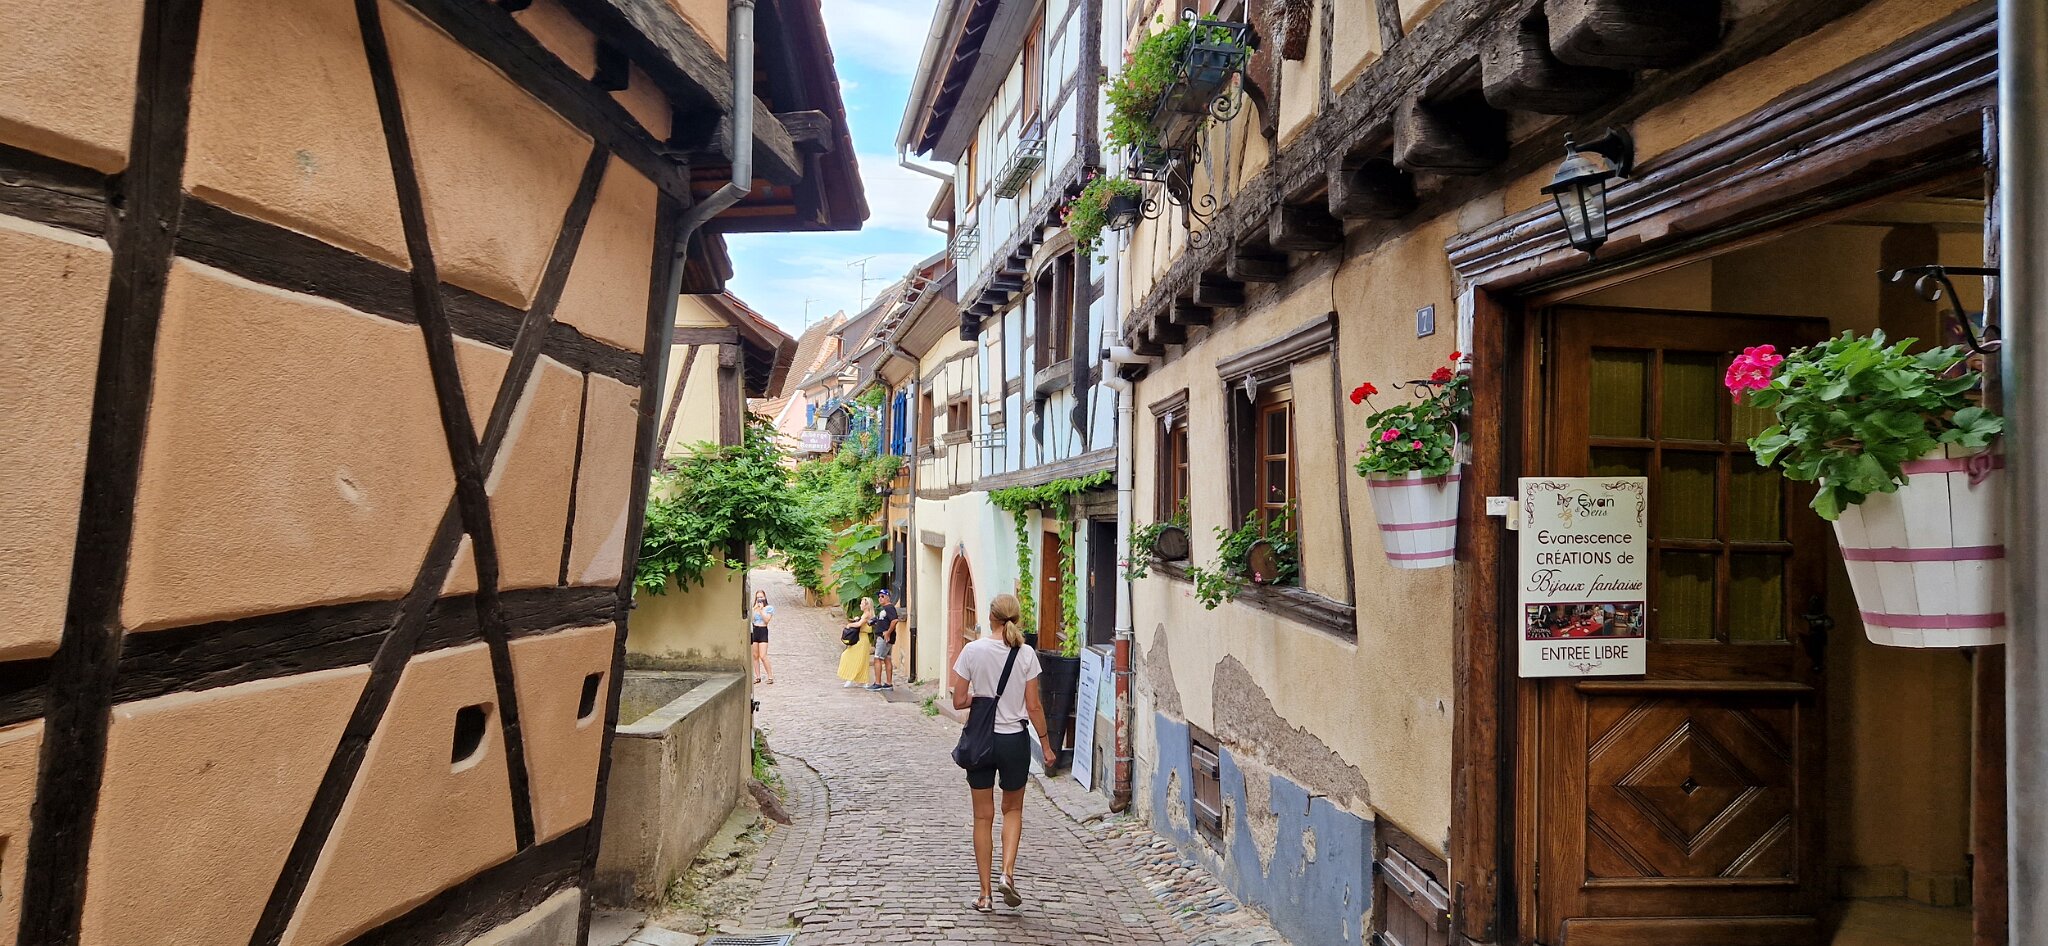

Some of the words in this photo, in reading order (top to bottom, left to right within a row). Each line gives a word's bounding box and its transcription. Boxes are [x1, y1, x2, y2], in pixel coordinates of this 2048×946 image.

[1421, 310, 1428, 332] 7
[1577, 493, 1615, 508] Evan
[1580, 502, 1608, 517] Sens
[1537, 530, 1632, 545] Evanescence
[1536, 550, 1612, 565] CRÉATIONS
[1616, 551, 1634, 564] de
[1526, 569, 1586, 598] Bijoux
[1586, 574, 1643, 598] fantaisie
[1541, 646, 1591, 661] ENTREE
[1595, 645, 1629, 660] LIBRE
